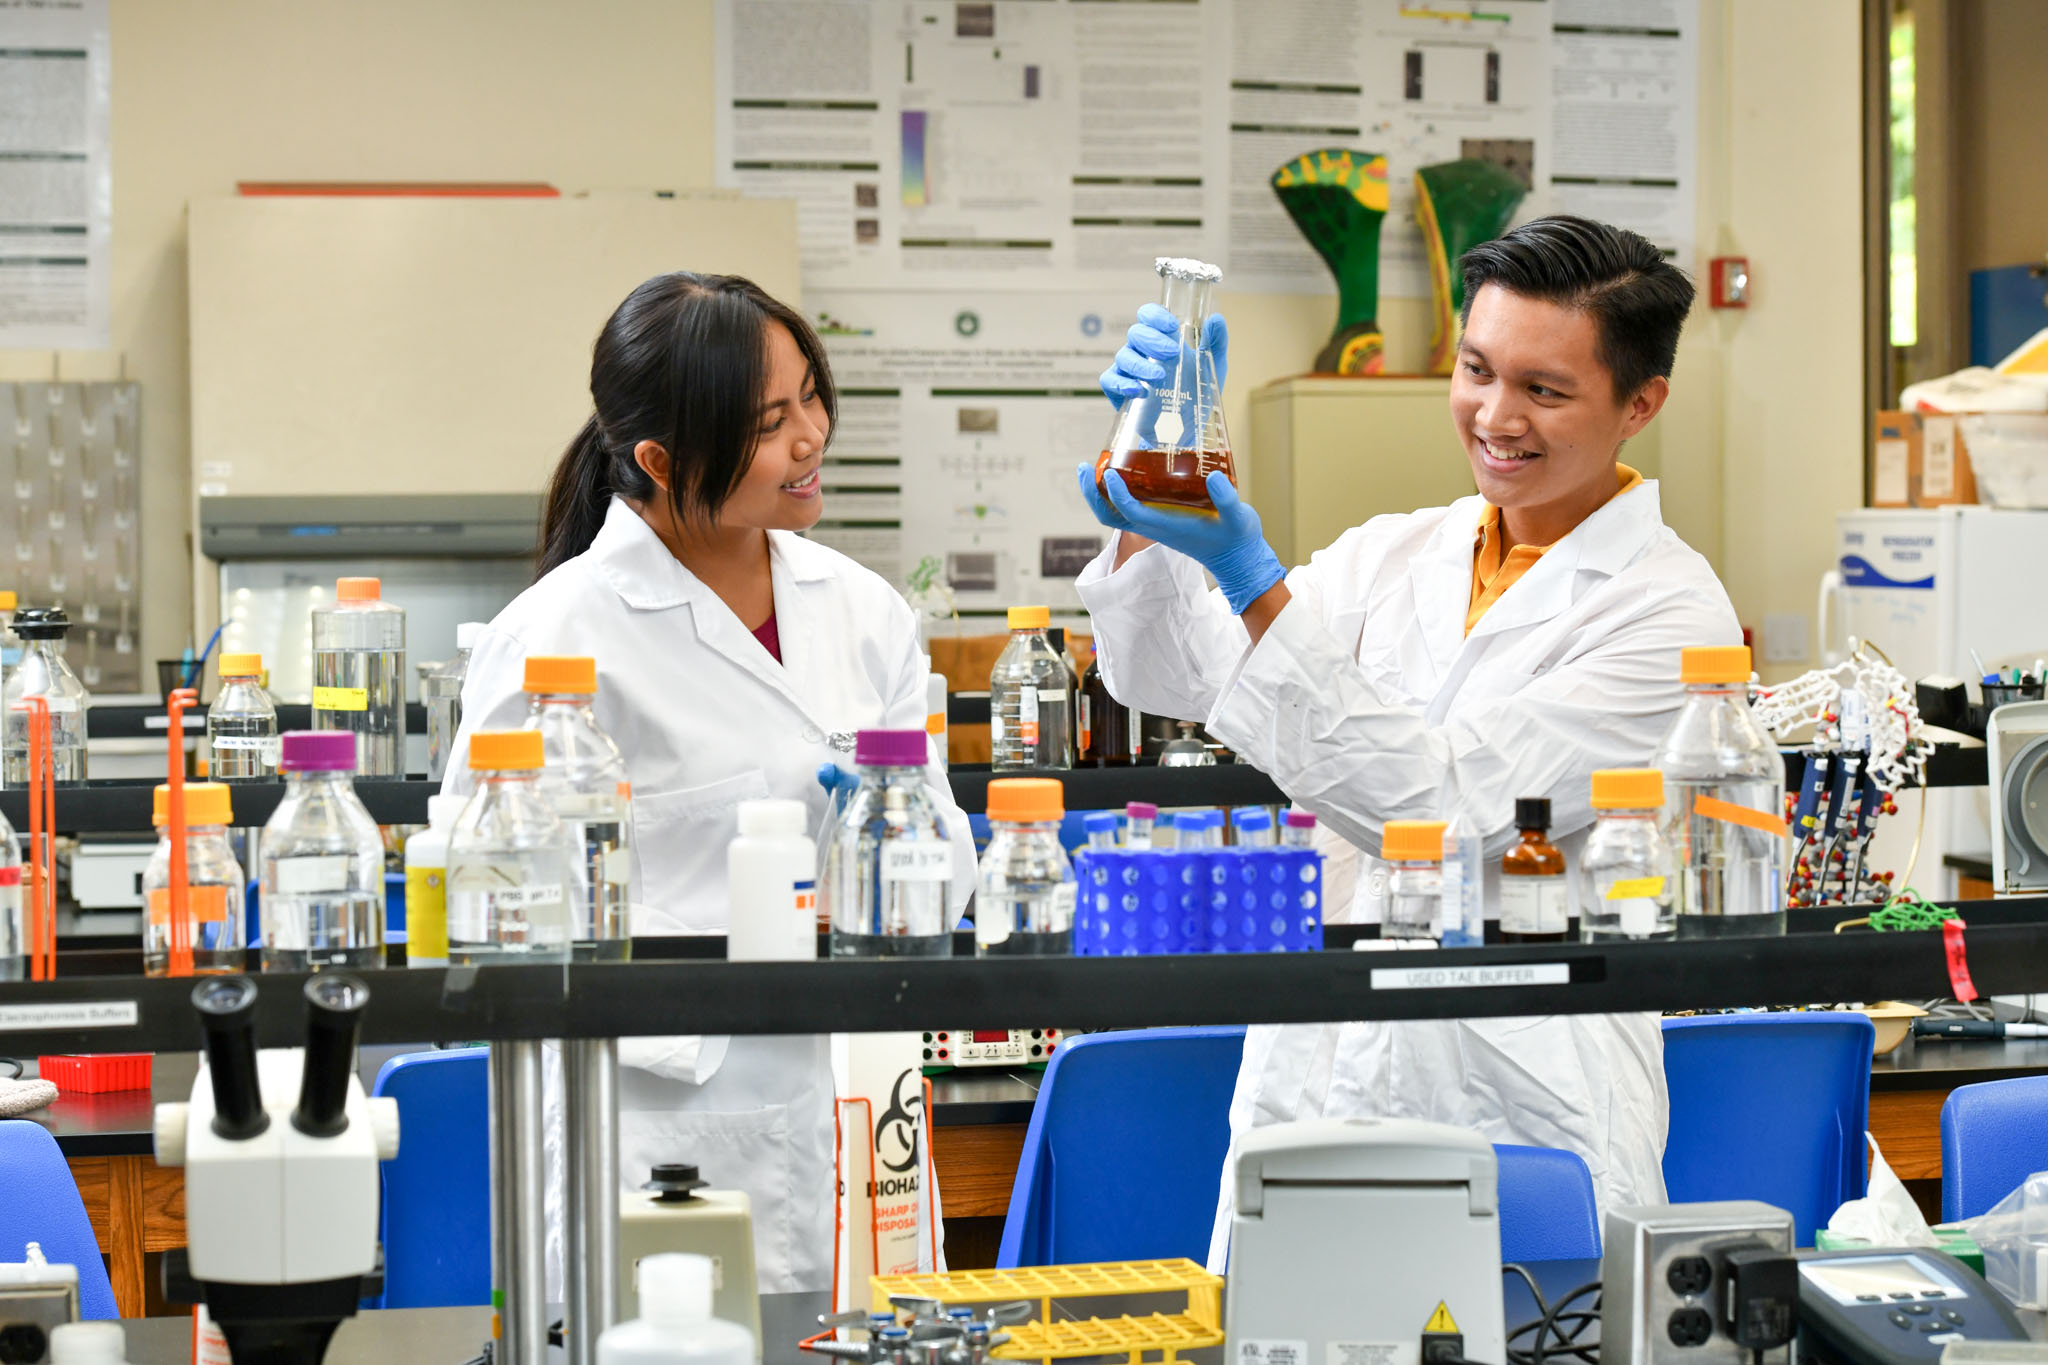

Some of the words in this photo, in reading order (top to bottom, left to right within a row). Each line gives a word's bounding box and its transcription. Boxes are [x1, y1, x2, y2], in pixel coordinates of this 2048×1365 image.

[1155, 388, 1175, 398] 1000
[1179, 391, 1193, 401] mL
[1406, 972, 1446, 986] USED
[1449, 971, 1474, 985] TAE
[1480, 968, 1535, 984] BUFFER
